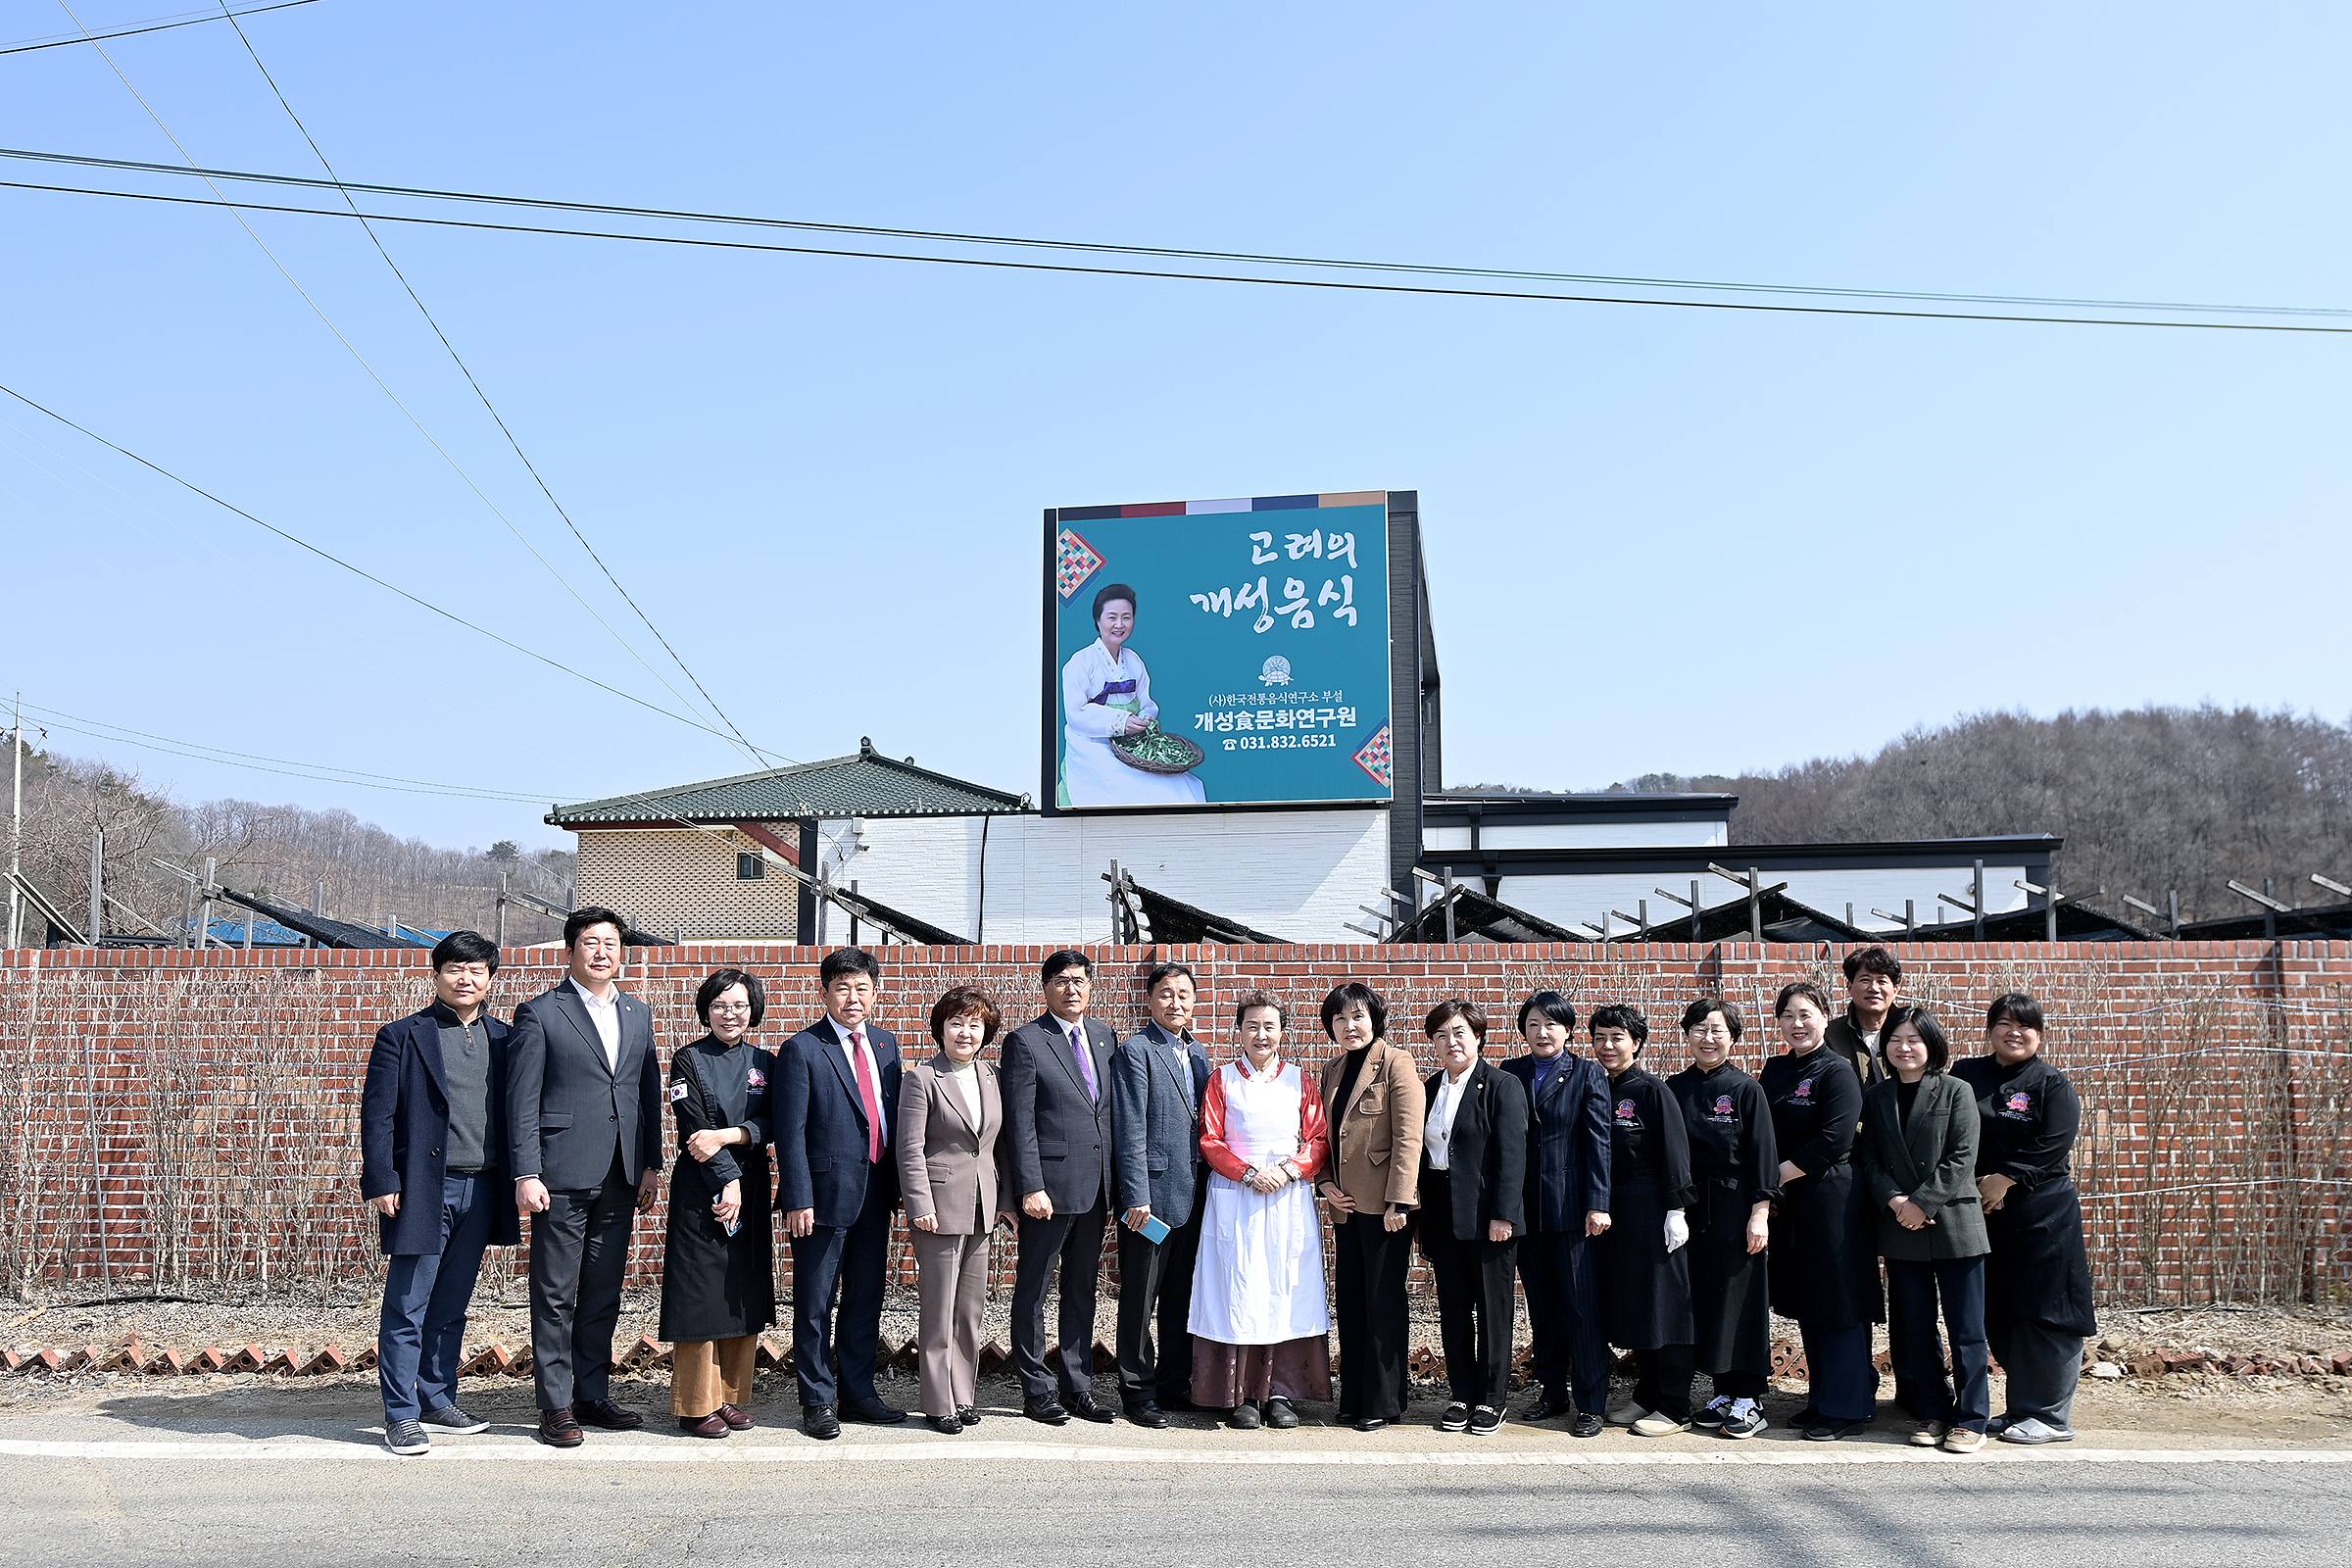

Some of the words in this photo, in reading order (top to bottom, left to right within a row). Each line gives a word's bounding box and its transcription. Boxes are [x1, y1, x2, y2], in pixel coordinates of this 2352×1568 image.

[1249, 527, 1358, 569] 고려의
[1189, 574, 1357, 634] 개성음식
[1208, 691, 1319, 707] (사)한국전통음식연구소
[1321, 689, 1343, 704] 부설
[1194, 706, 1357, 732] 개성食문화연구원
[1240, 734, 1337, 750] 031.832.6521
